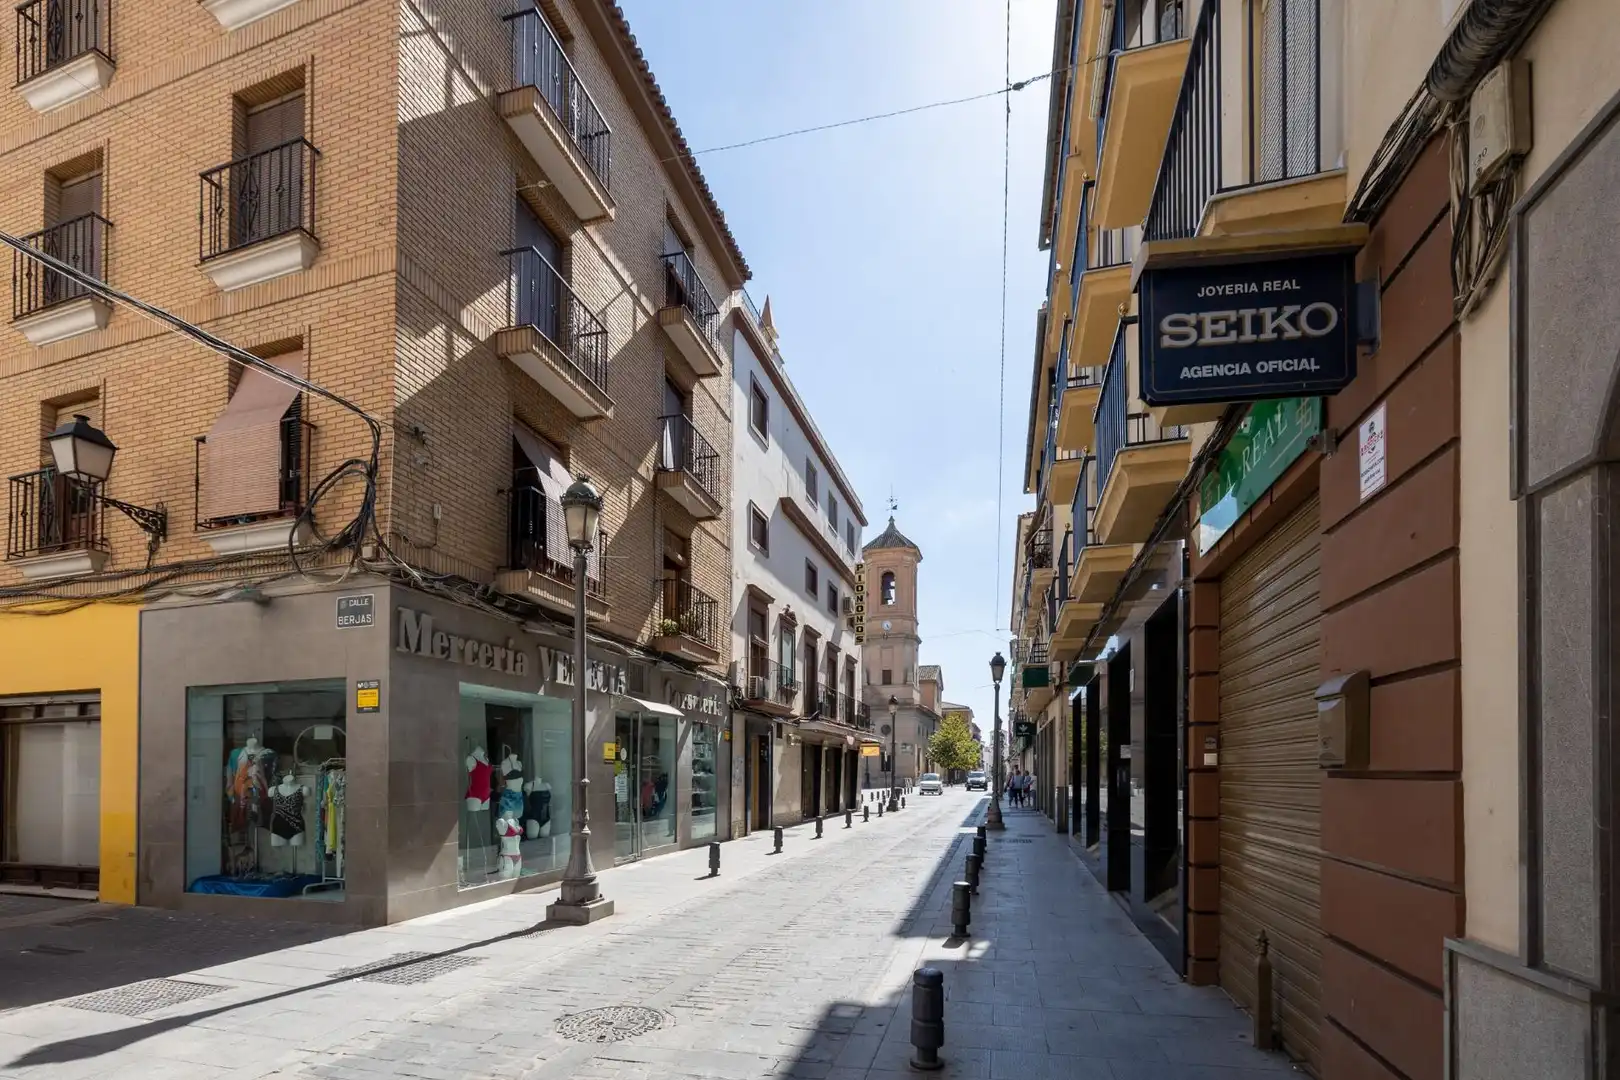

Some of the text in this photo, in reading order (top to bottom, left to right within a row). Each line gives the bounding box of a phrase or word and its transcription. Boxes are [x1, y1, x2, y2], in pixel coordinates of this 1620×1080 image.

[1197, 279, 1301, 297] JOYERIA REAL
[1160, 302, 1338, 348] SEIKO
[1180, 357, 1320, 379] AGENCIA OFICIAL
[1242, 402, 1288, 480] REAL
[349, 598, 369, 607] CALLE
[856, 564, 864, 643] PIONONOS
[338, 614, 372, 625] BERJAS
